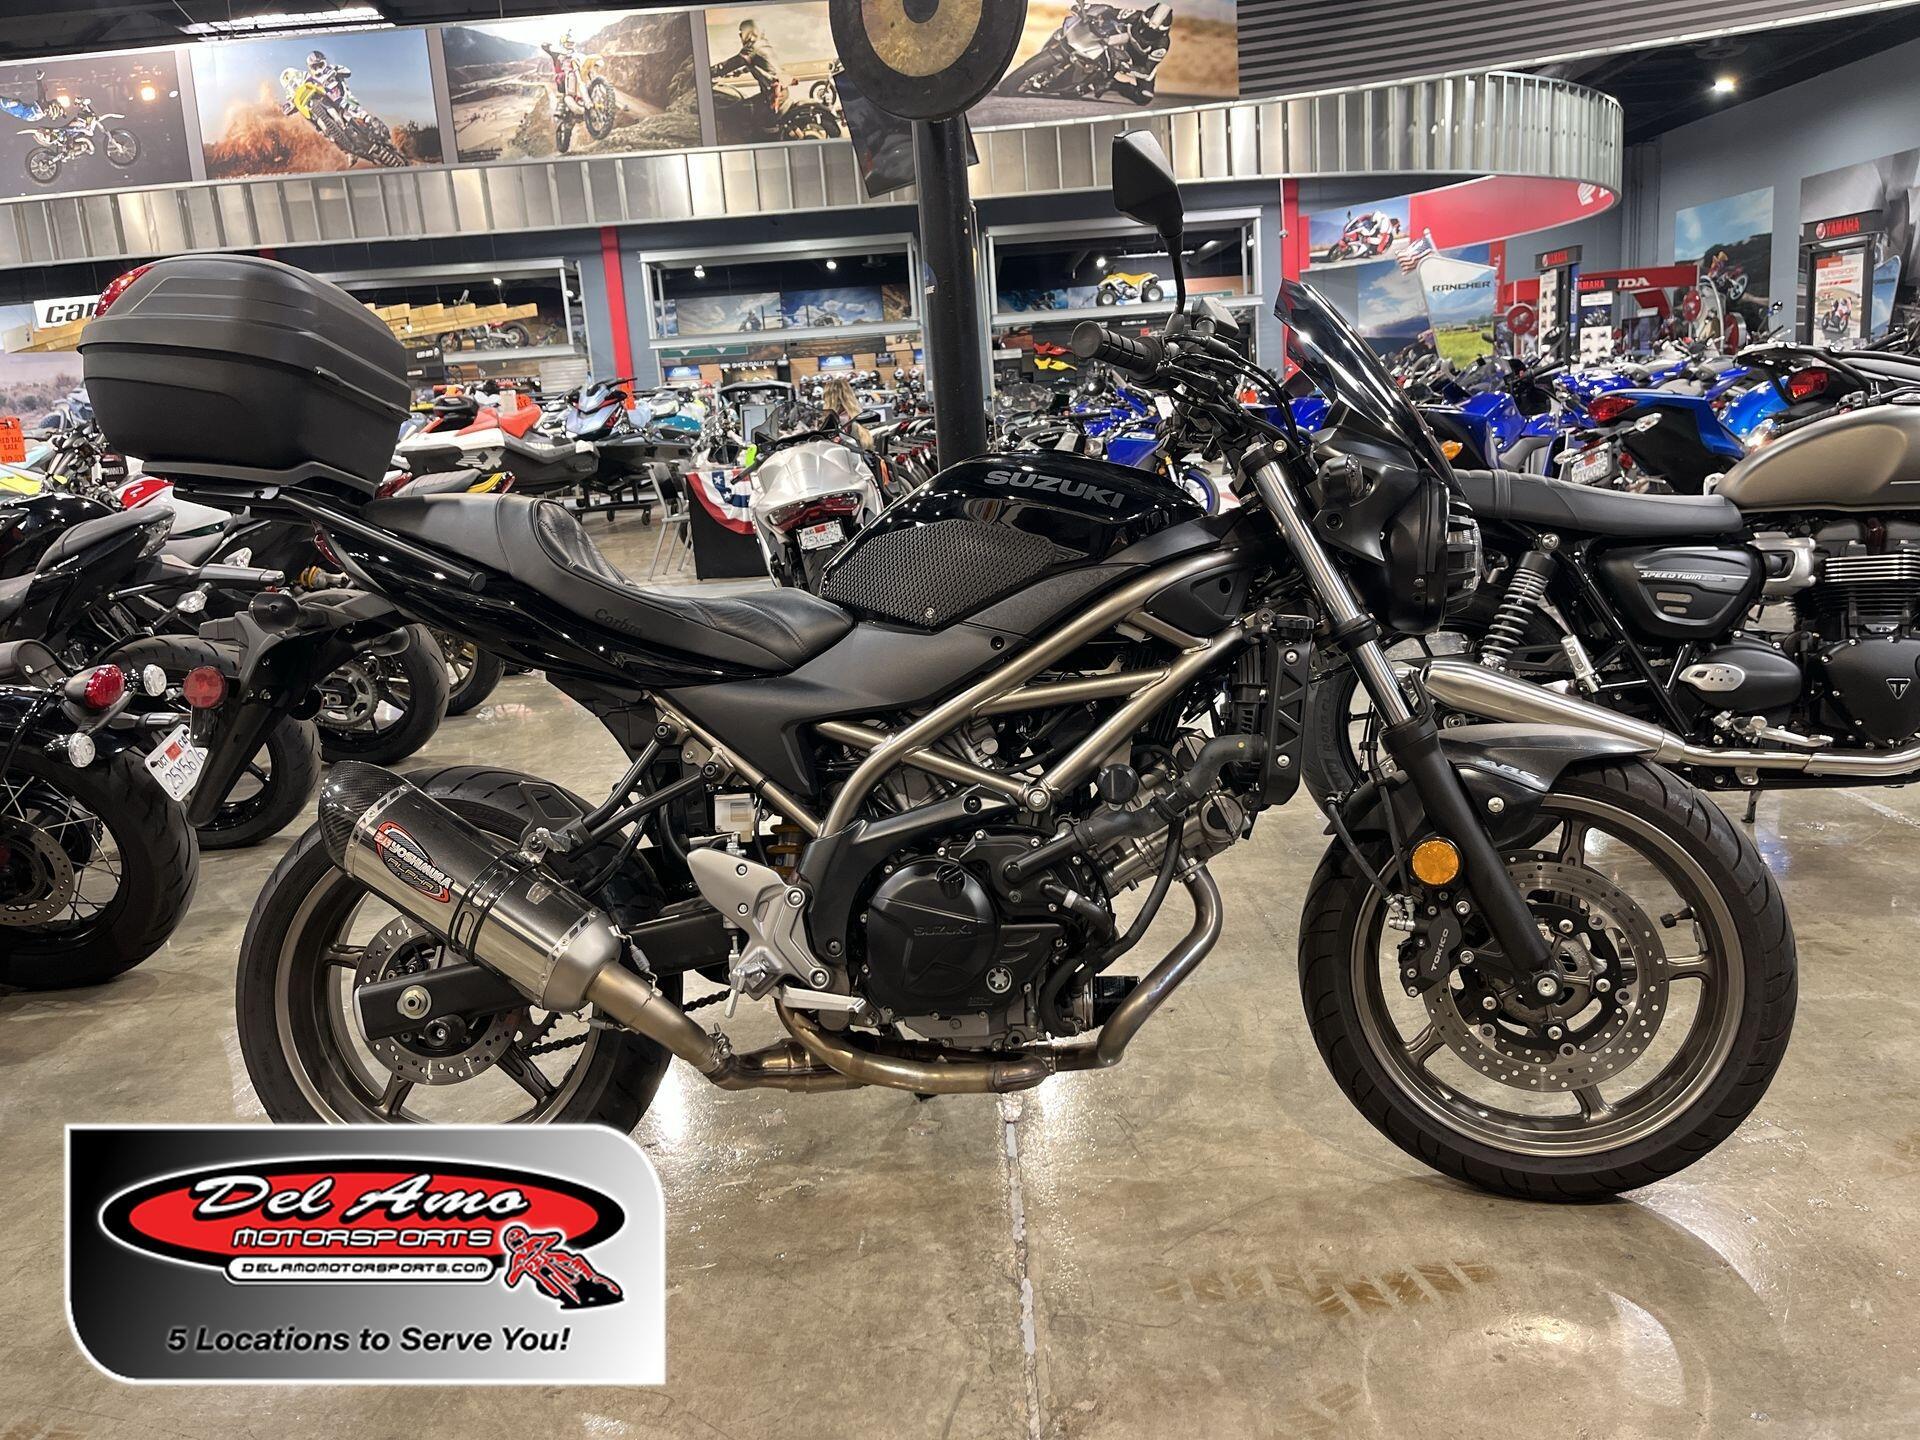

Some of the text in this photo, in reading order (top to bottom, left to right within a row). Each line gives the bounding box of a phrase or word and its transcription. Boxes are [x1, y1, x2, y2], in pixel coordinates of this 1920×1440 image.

[1826, 217, 1860, 236] YAMAHA
[1432, 280, 1491, 292] RANCHER
[1578, 279, 1606, 290] AMAHA
[984, 470, 1125, 508] SUZUKI
[387, 857, 434, 890] ALPHA
[389, 840, 453, 890] YOSHIMURA
[1431, 928, 1449, 971] TOKICO
